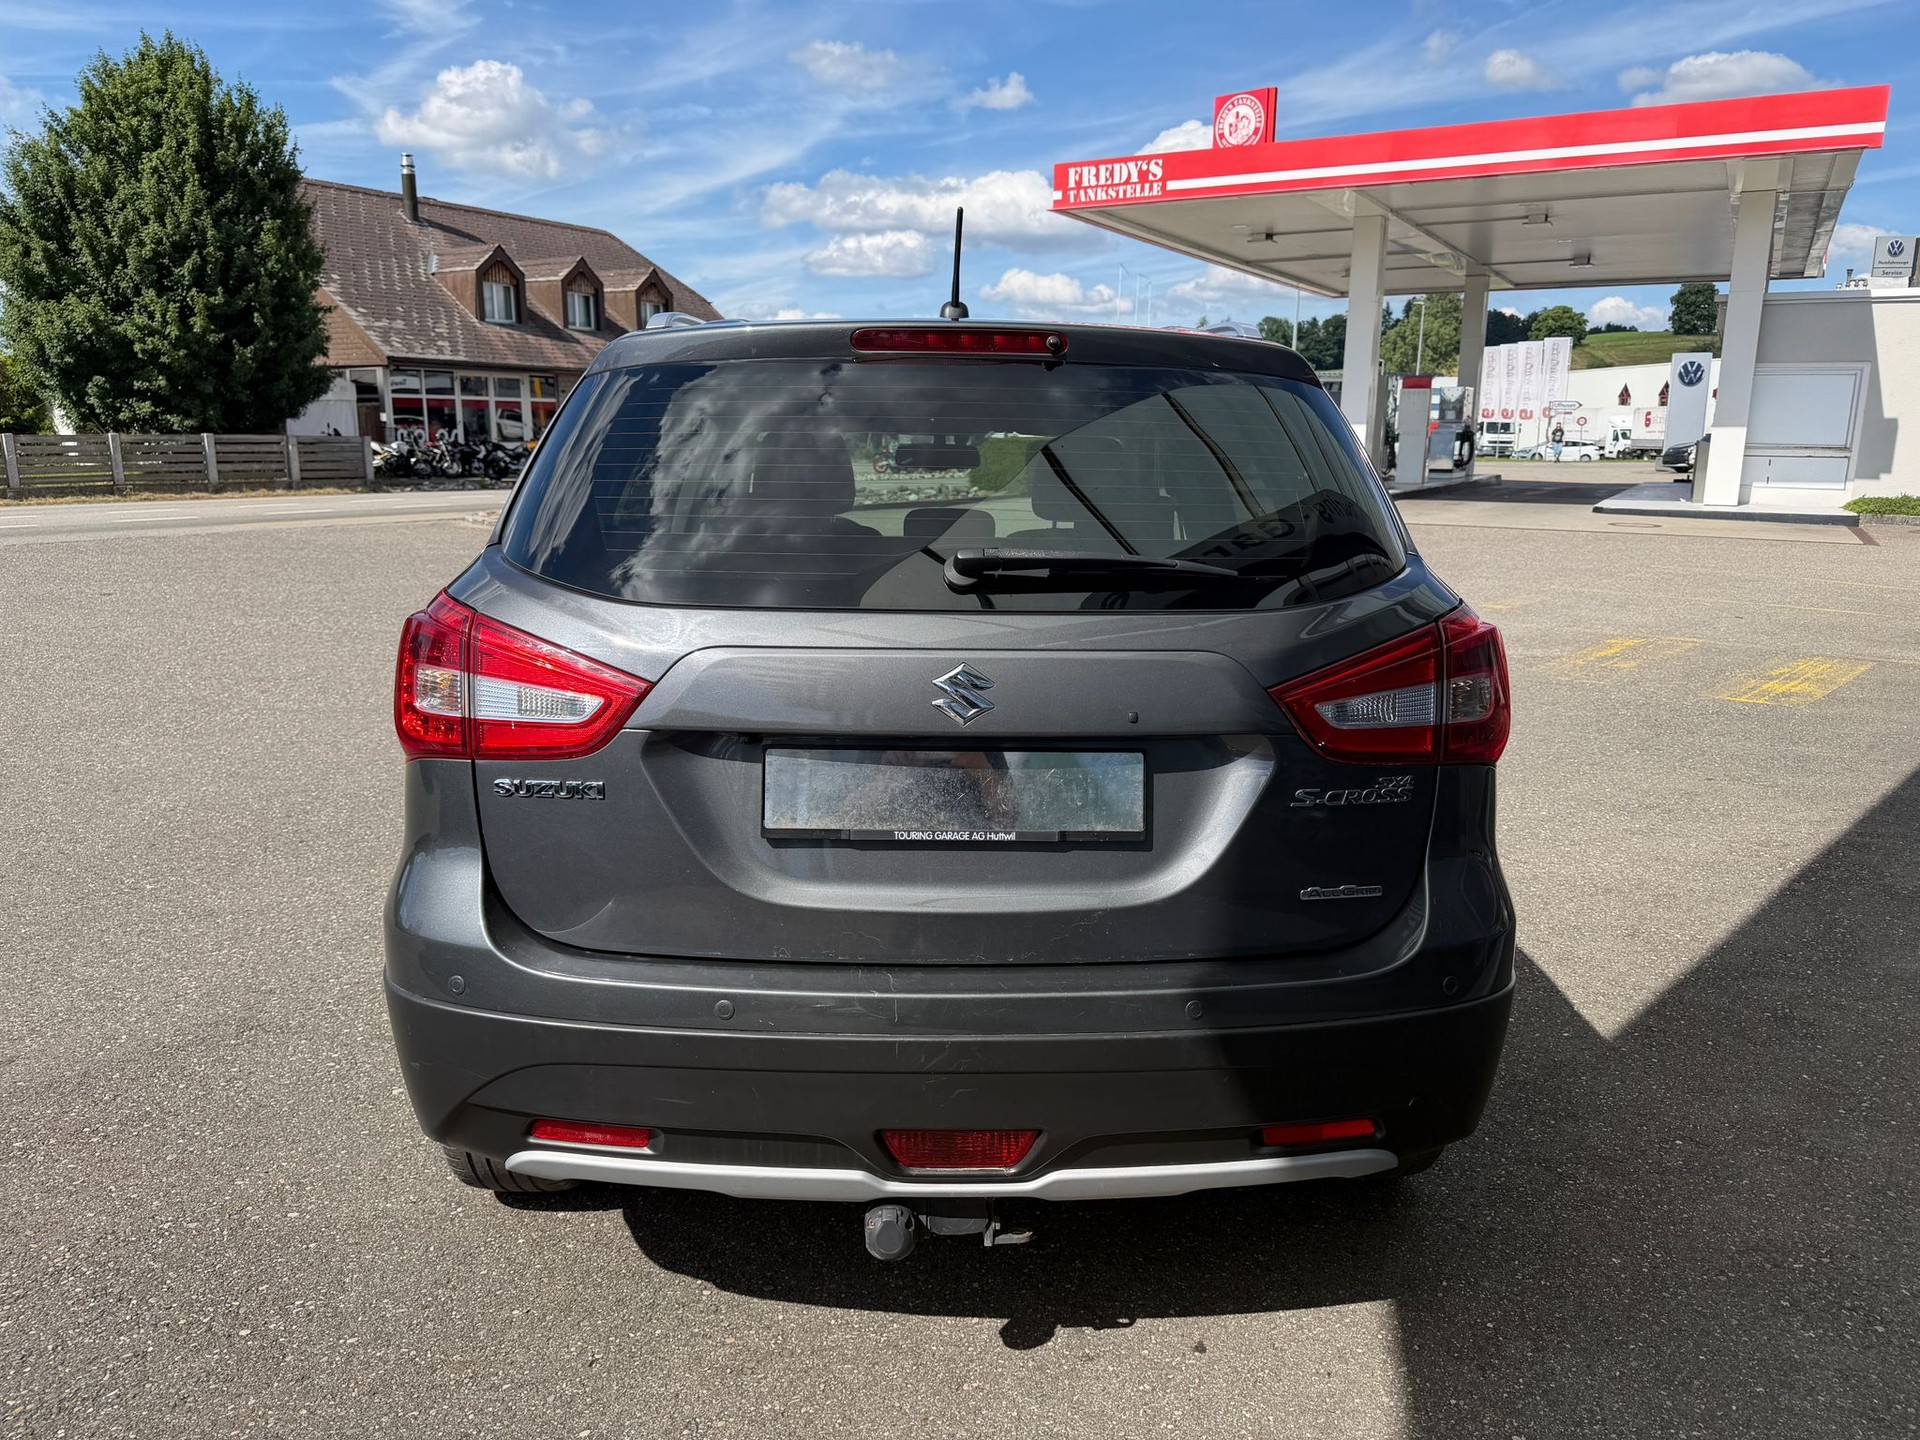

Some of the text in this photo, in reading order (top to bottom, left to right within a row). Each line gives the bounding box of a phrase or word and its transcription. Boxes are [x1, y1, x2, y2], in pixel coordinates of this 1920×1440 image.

[1067, 159, 1163, 188] FREDY'S
[1067, 182, 1162, 203] TANKSTELLE
[493, 778, 605, 800] SUZUKI
[894, 831, 1016, 840] TOURING GARAGE AG Huttwil
